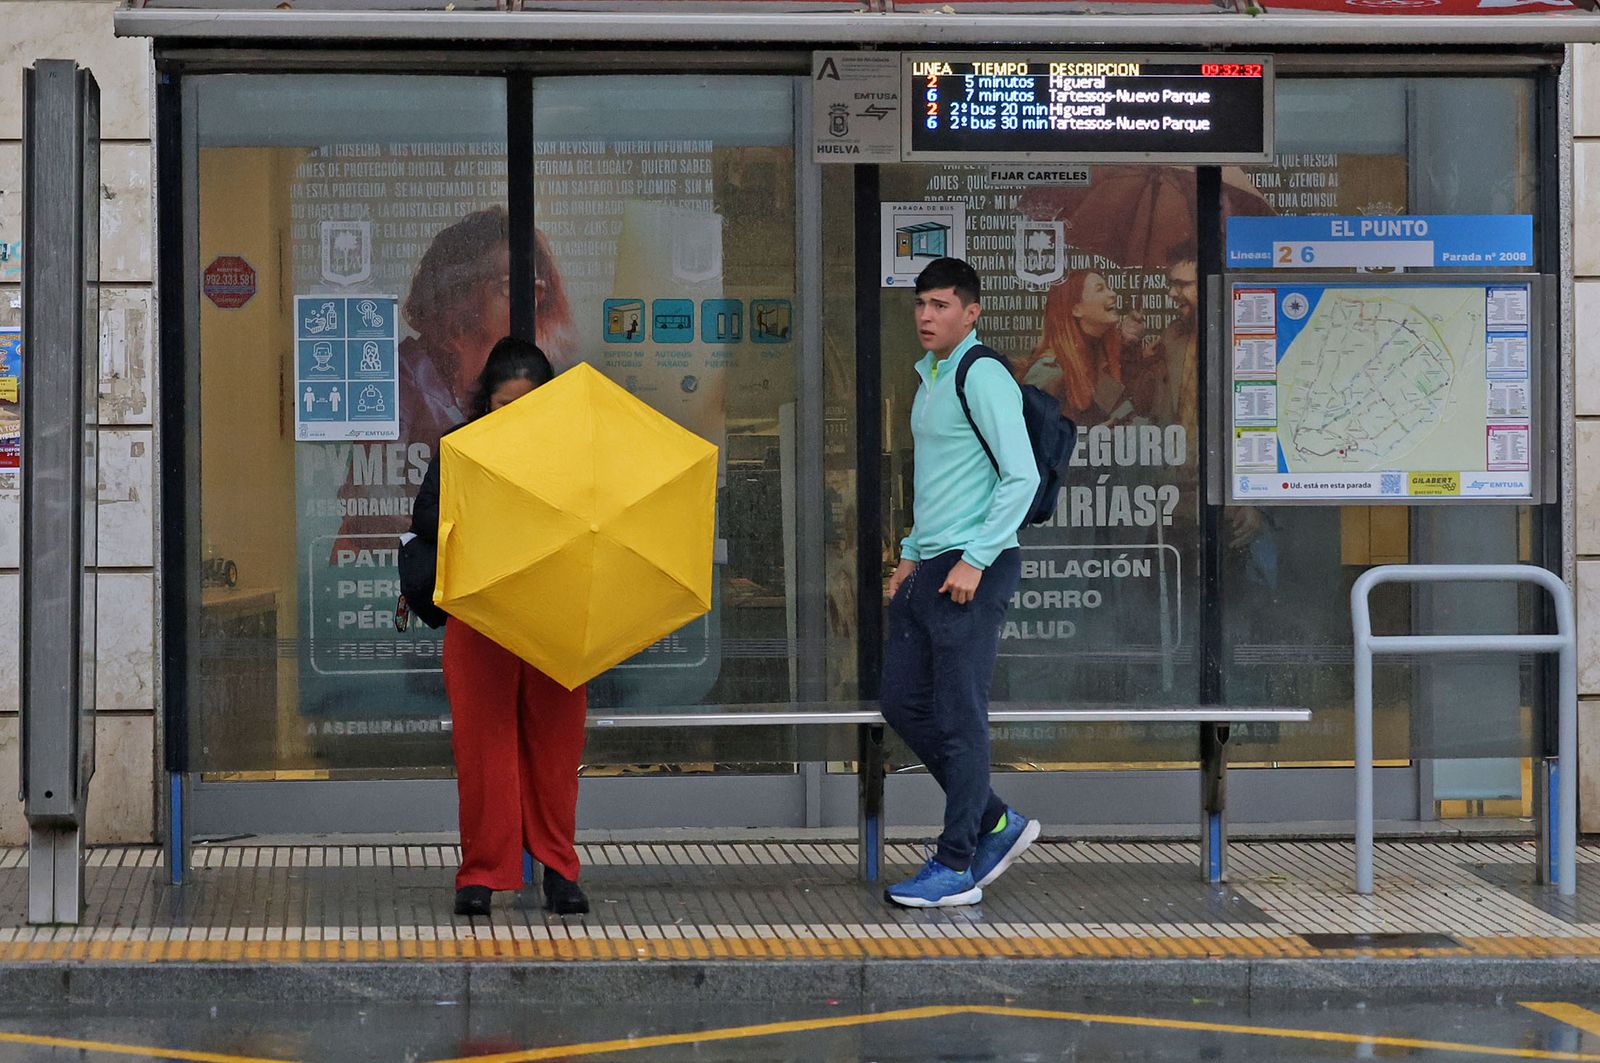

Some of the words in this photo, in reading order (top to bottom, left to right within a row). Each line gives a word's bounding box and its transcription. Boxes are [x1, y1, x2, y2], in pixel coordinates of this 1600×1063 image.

[912, 62, 953, 76] LINEA
[972, 62, 1029, 76] TIEMPO
[1049, 62, 1141, 76] DESCRIPCION
[1201, 64, 1263, 77] 09:32:32
[926, 75, 938, 88] 2
[965, 75, 974, 88] 5
[978, 75, 1035, 88] minutos
[1049, 75, 1106, 90] Higueral
[854, 92, 898, 100] EMTUSA
[926, 88, 938, 101] 6
[965, 88, 974, 102] 7
[978, 88, 1035, 101] minutos
[1048, 89, 1160, 103] Tartessos-Nuevo
[1162, 89, 1211, 105] Parque
[926, 102, 938, 115] 2
[949, 102, 968, 115] 2º
[970, 102, 996, 116] bus
[1000, 102, 1018, 116] 20
[1021, 102, 1049, 116] min
[1049, 103, 1106, 118] Higueral
[926, 116, 938, 129] 6
[949, 116, 968, 129] 2º
[970, 116, 996, 129] bus
[1000, 116, 1018, 129] 30
[1021, 116, 1049, 129] min
[1048, 117, 1160, 131] Tartessos-Nuevo
[1162, 117, 1211, 133] Parque
[816, 145, 860, 154] HUELVA
[407, 161, 446, 176] DIGITAL
[576, 159, 595, 175] DEL
[597, 159, 633, 175] LOCAL?
[641, 159, 677, 175] QUIERO
[679, 158, 712, 174] SABER
[991, 171, 1024, 182] FIJAR
[1027, 171, 1088, 182] CARTELES
[395, 182, 408, 197] SE
[426, 181, 474, 199] QUEMADO
[616, 180, 634, 195] LOS
[637, 179, 677, 195] PLOMOS
[994, 195, 1007, 210] MI
[1278, 192, 1299, 207] UNA
[1330, 219, 1354, 237] EL
[1360, 219, 1429, 237] PUNTO
[1278, 245, 1293, 263] 2
[1301, 245, 1316, 263] 6
[1442, 251, 1482, 262] Parada
[1484, 251, 1498, 262] nº
[1499, 251, 1528, 262] 2008
[1071, 255, 1091, 270] UNA
[1129, 274, 1141, 289] LE
[1025, 295, 1038, 310] UN
[1013, 315, 1033, 330] CON
[303, 443, 431, 486] PYMES
[1304, 481, 1319, 490] está
[1346, 481, 1372, 491] parada
[1412, 477, 1453, 485] GILABERT
[1020, 554, 1151, 579] BILACIÓN
